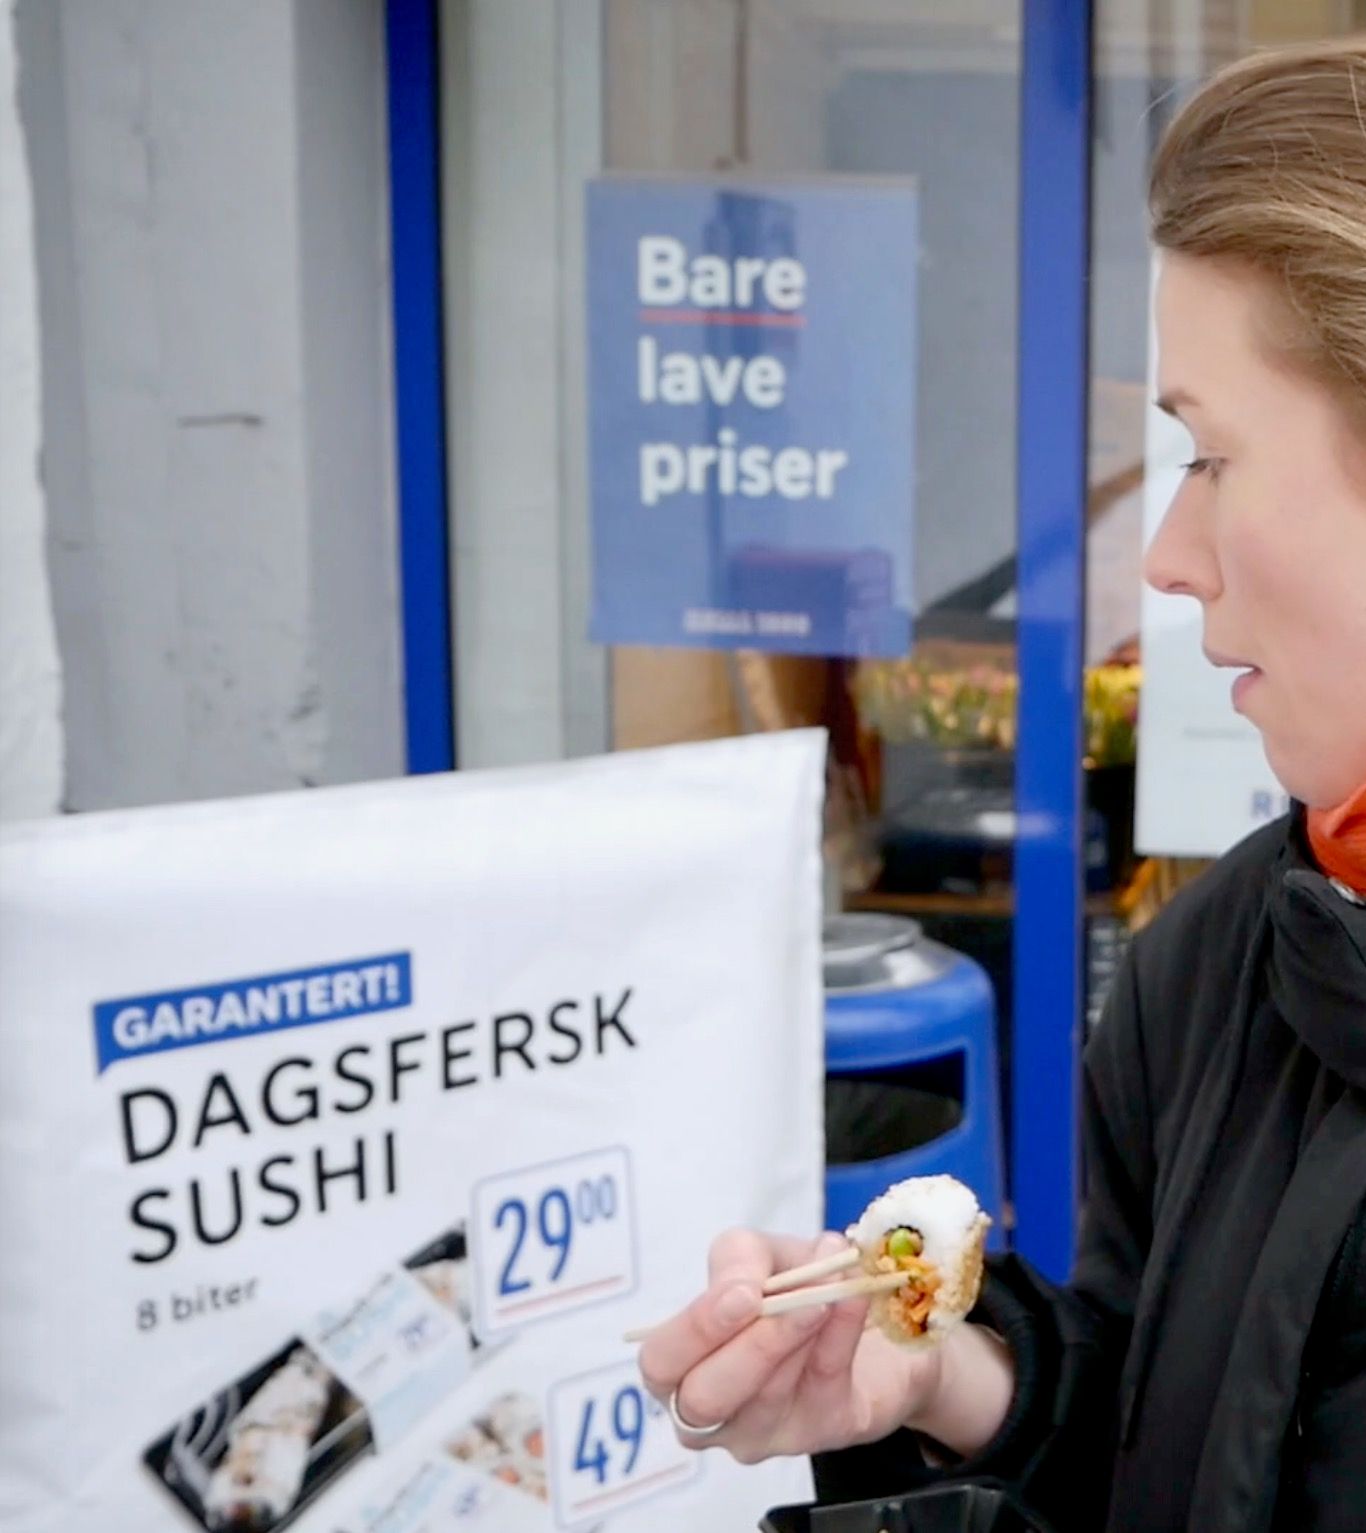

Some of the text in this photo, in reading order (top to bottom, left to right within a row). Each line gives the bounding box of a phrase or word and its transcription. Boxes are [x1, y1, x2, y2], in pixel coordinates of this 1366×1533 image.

[638, 235, 806, 311] Bare
[638, 334, 786, 409] lave
[640, 426, 848, 507] priser
[111, 963, 401, 1050] GARANTERT!
[118, 986, 638, 1166] DAGSFERSK
[129, 1130, 398, 1265] SUSHI
[137, 1274, 259, 1332] 8 biter
[573, 1384, 643, 1484] 49
